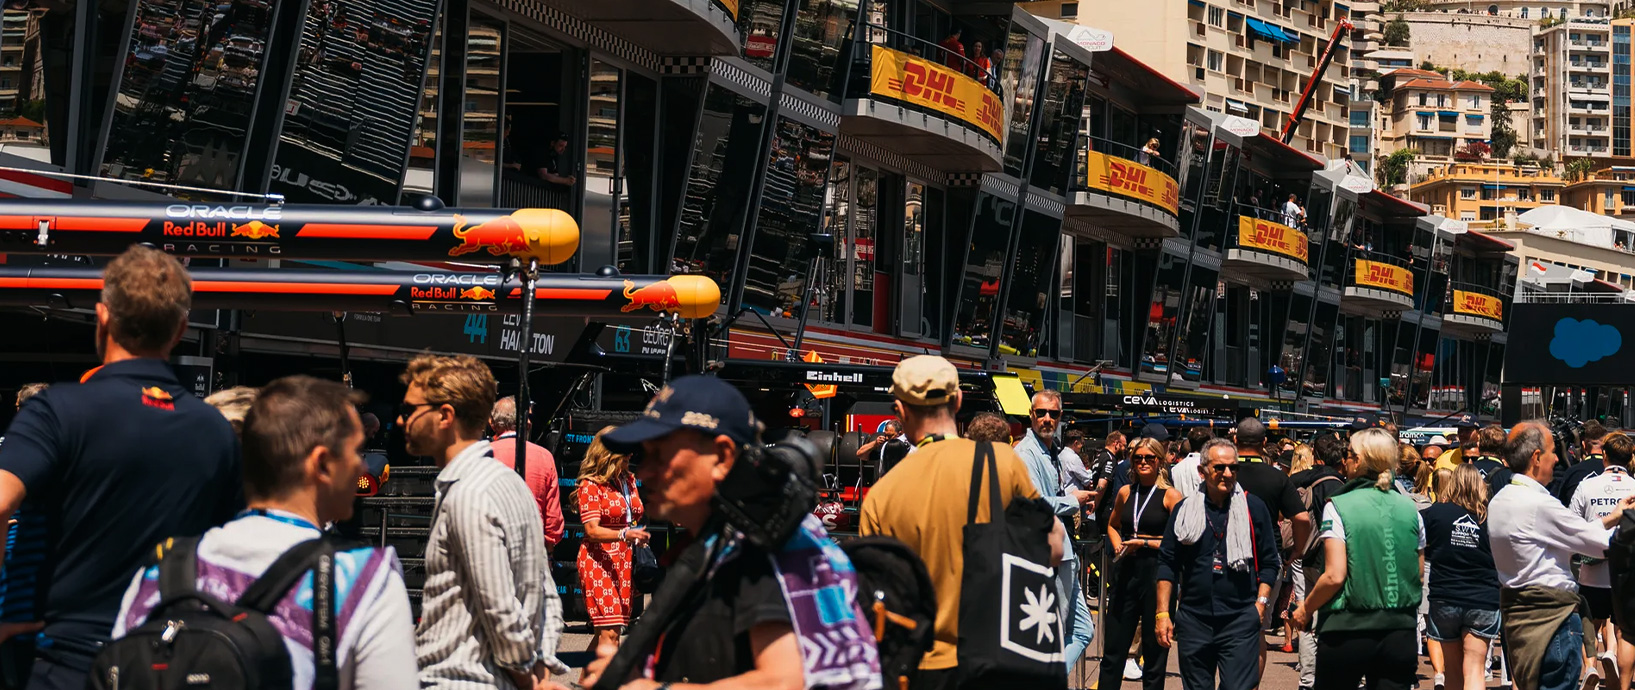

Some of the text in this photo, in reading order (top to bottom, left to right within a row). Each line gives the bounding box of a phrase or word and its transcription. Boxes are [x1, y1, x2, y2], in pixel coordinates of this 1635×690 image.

[902, 61, 957, 108] DHL
[1109, 162, 1148, 195] DHL
[165, 204, 282, 220] ORACLE
[163, 221, 226, 237] Red Bull
[1255, 224, 1287, 250] DHL
[164, 243, 280, 254] RACING
[412, 273, 497, 285] ORACLE
[1370, 265, 1396, 286] DHL
[411, 286, 456, 299] Red Bull
[412, 303, 497, 311] RACING
[1464, 295, 1488, 313] DHL
[463, 314, 487, 344] 44
[615, 324, 631, 352] 63
[642, 325, 671, 347] GEORG
[806, 371, 863, 383] Einhell
